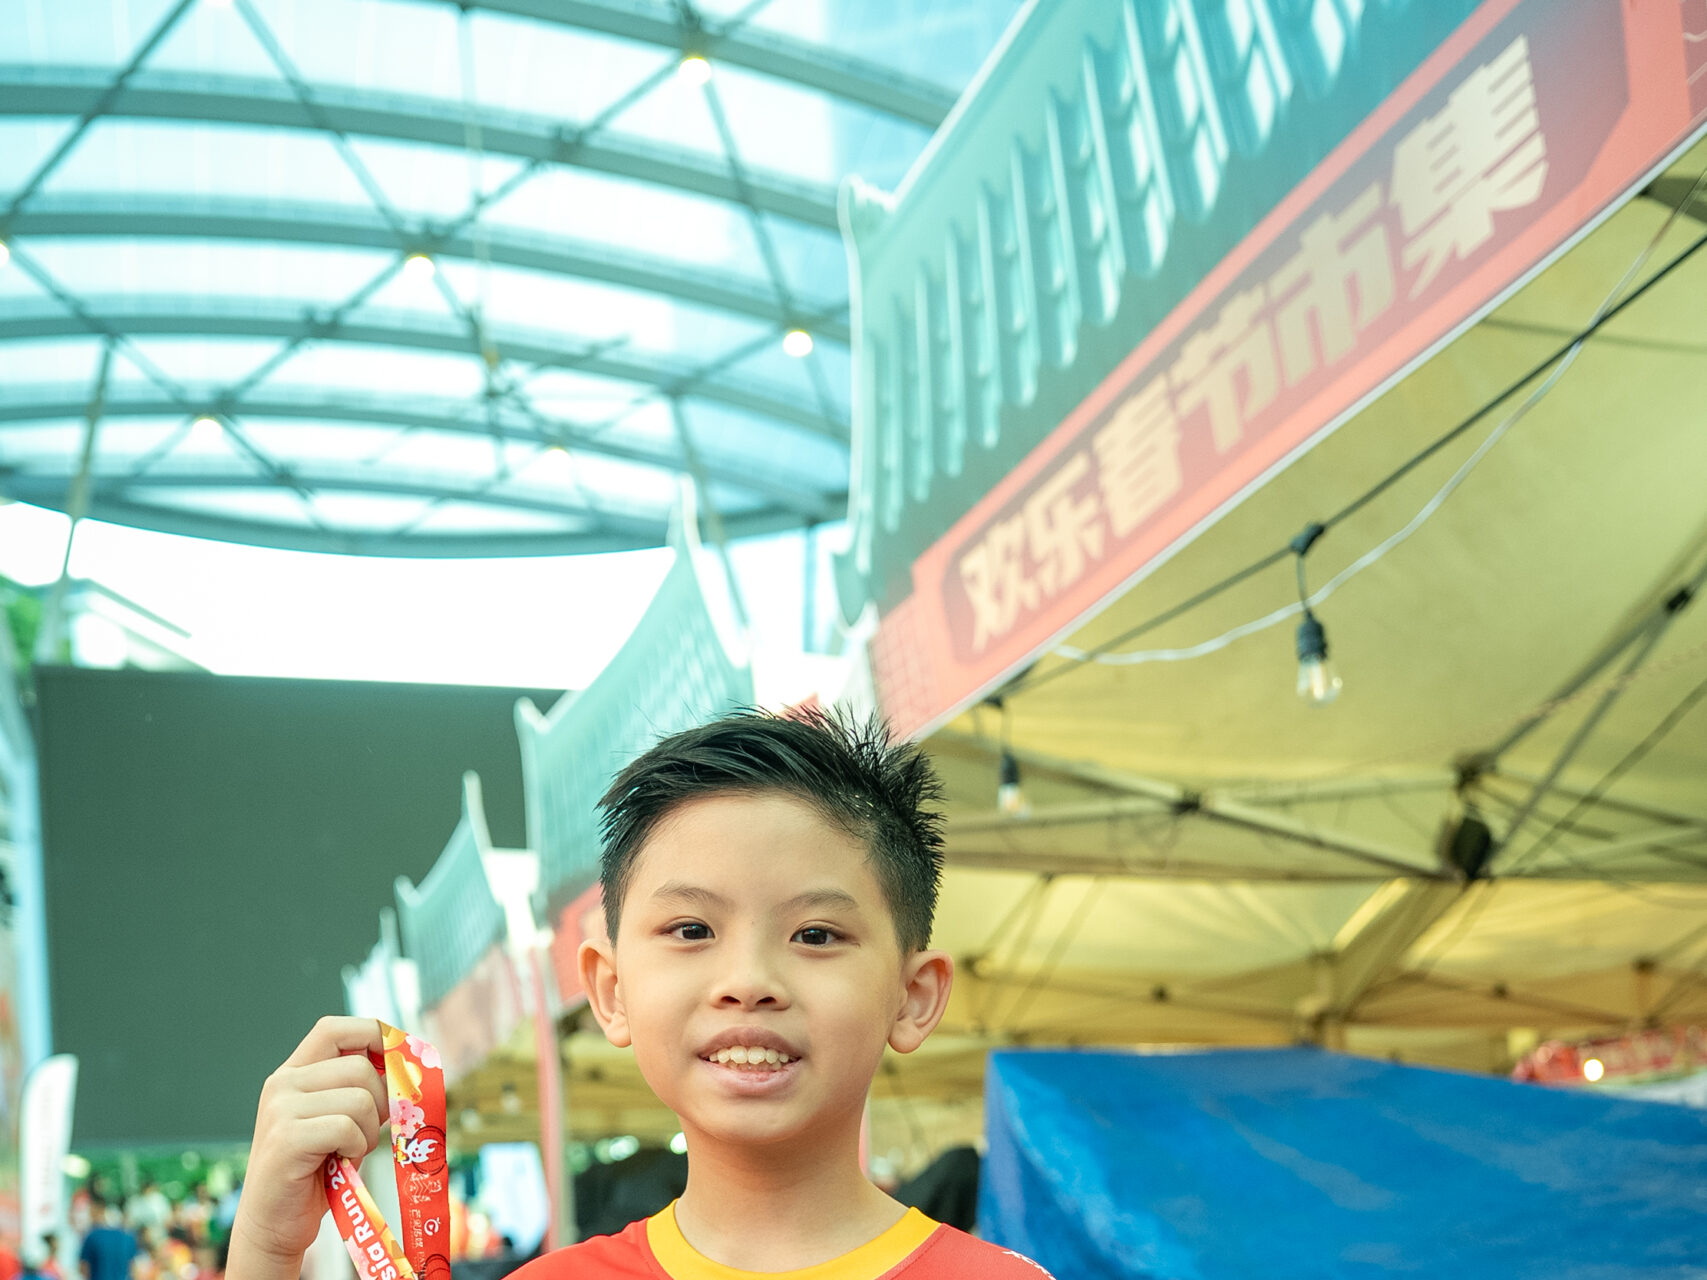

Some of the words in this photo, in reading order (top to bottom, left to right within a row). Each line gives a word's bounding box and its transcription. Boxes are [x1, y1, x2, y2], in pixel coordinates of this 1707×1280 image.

[960, 33, 1549, 651] 欢乐春节市集
[341, 1191, 375, 1244] Run
